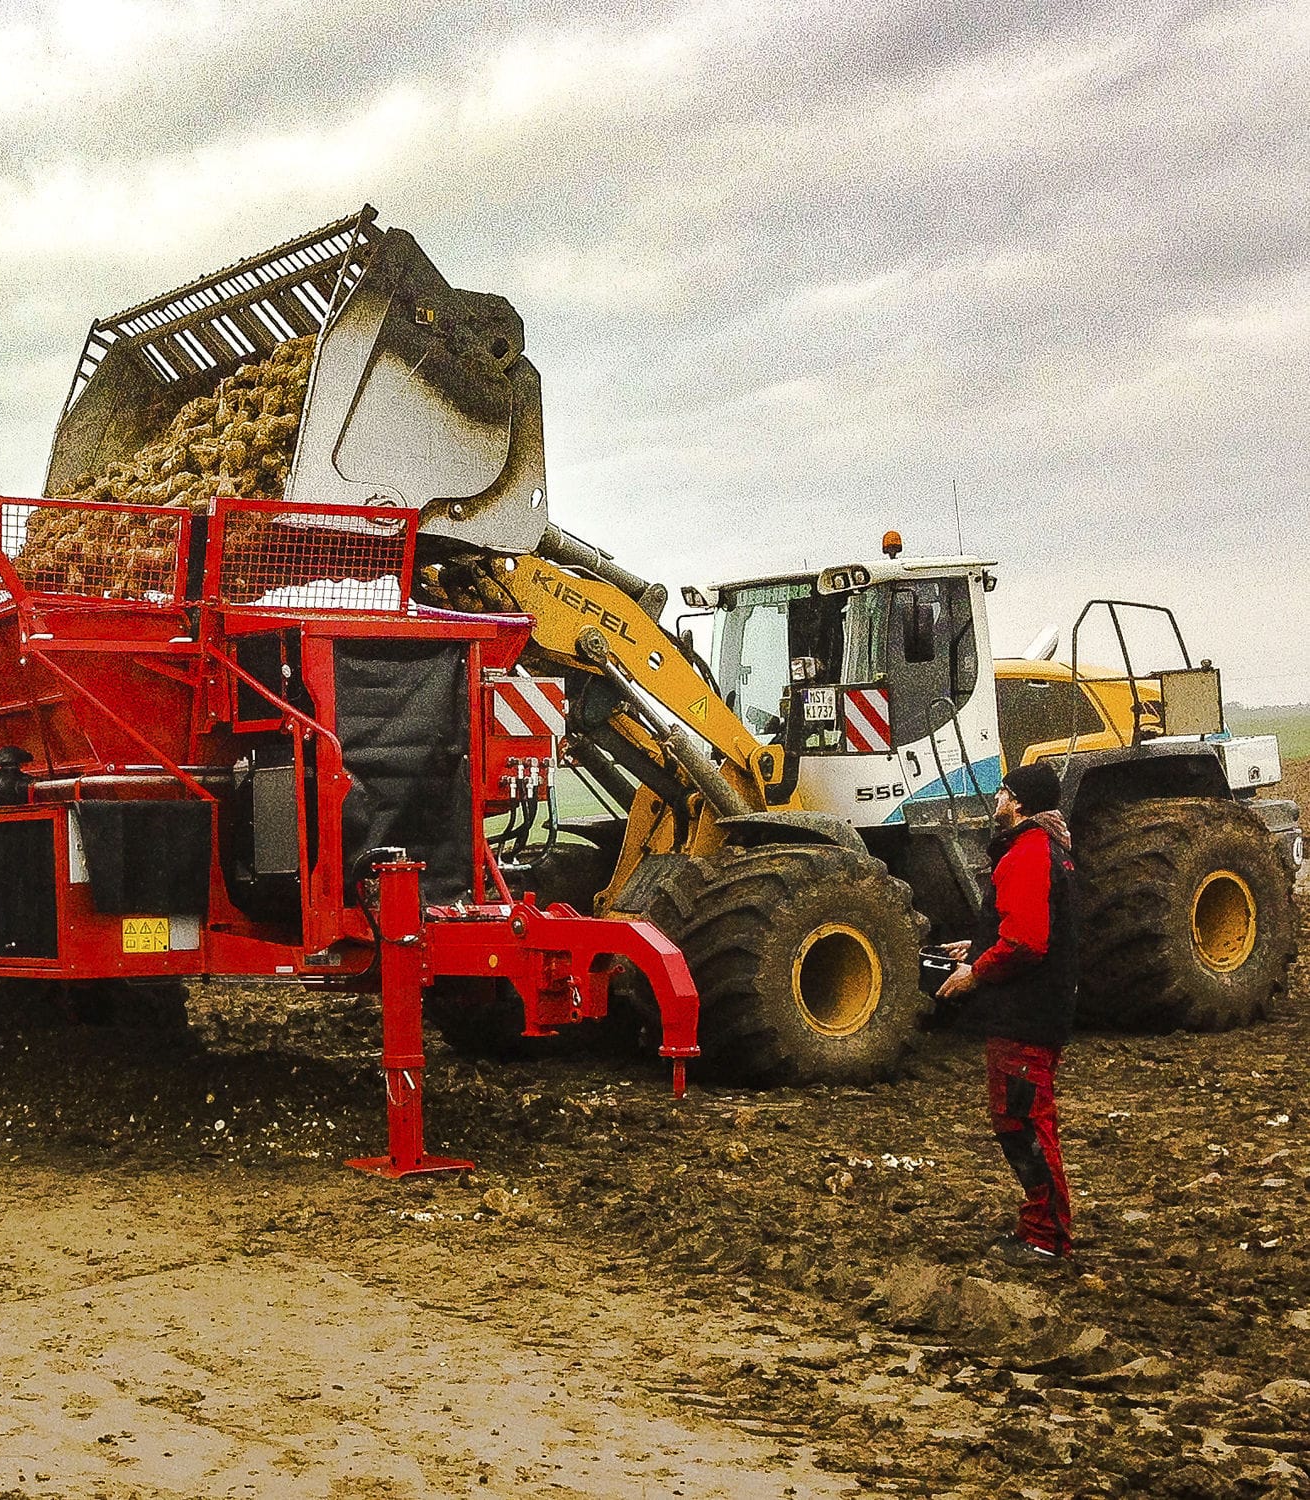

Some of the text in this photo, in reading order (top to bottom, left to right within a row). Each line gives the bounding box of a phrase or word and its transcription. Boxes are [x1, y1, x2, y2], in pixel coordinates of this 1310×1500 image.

[531, 569, 637, 645] KIEFEL
[810, 690, 826, 704] MST
[856, 783, 905, 802] 556
